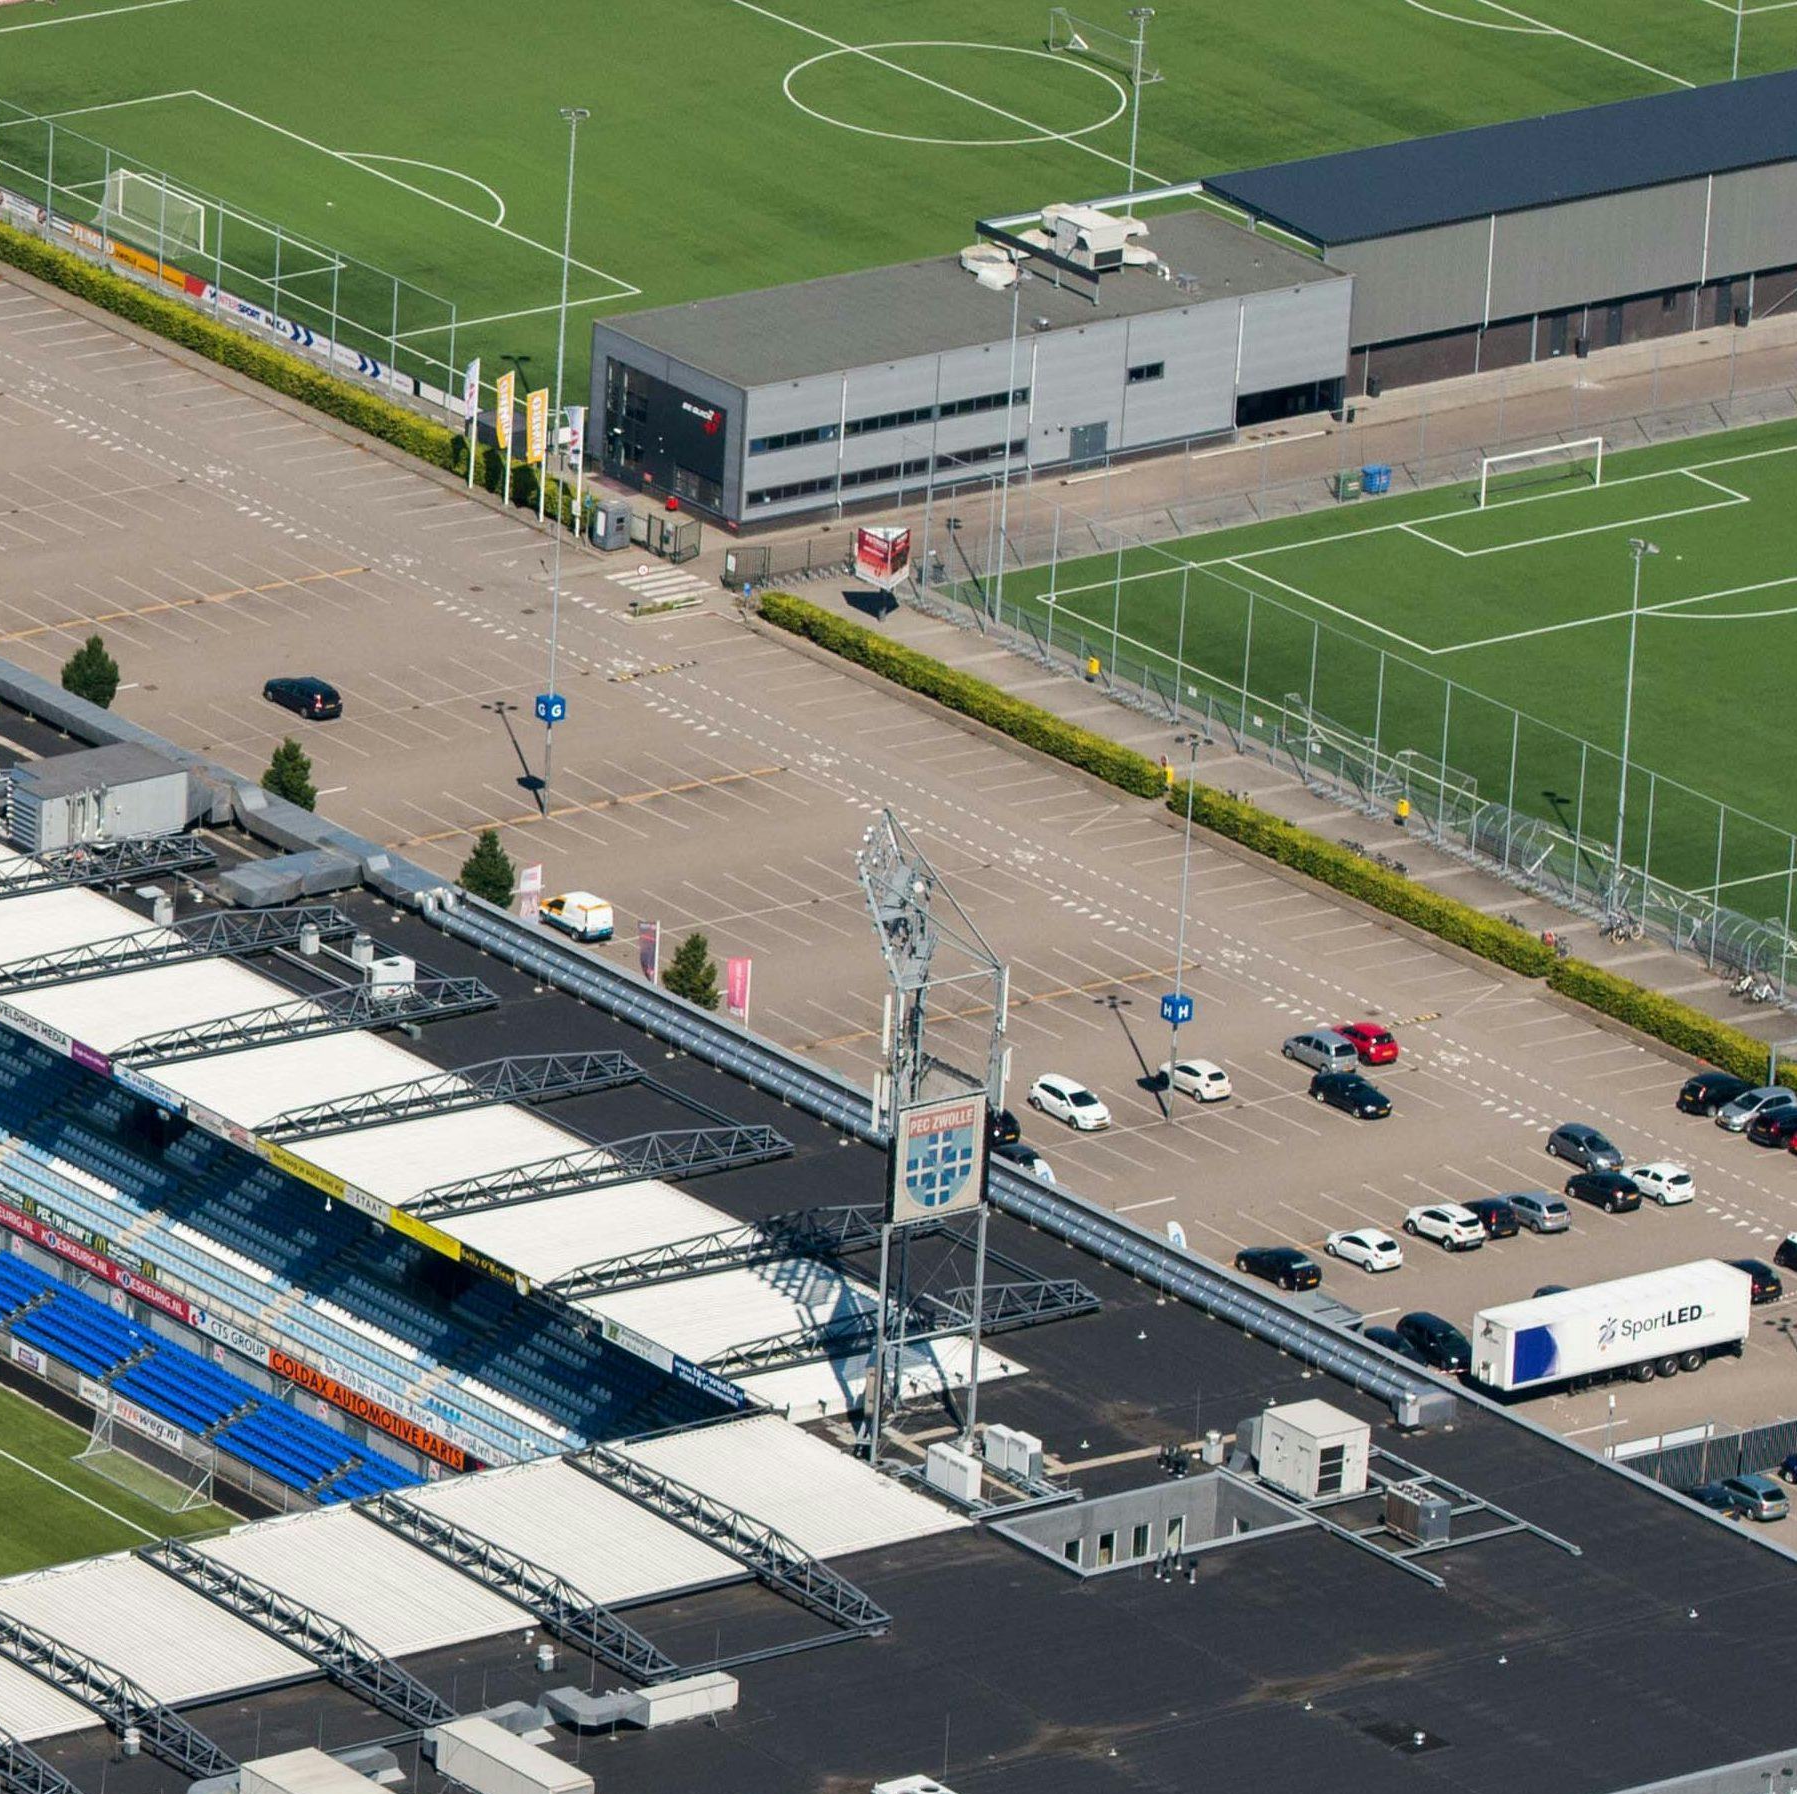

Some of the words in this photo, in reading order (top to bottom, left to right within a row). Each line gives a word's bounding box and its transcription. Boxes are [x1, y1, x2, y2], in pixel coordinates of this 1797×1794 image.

[551, 704, 562, 717] G
[1178, 1005, 1189, 1019] H
[40, 1023, 68, 1047] MEDIA
[910, 1116, 930, 1136] PEC
[932, 1107, 974, 1130] ZWOLLE
[1621, 1304, 1703, 1341] SportLED
[210, 1319, 230, 1341] CTS
[231, 1327, 266, 1360] GROUP
[272, 1352, 328, 1396] COLDAX
[333, 1385, 419, 1446] AUTOMOTIVE
[422, 1430, 464, 1469] PARTS
